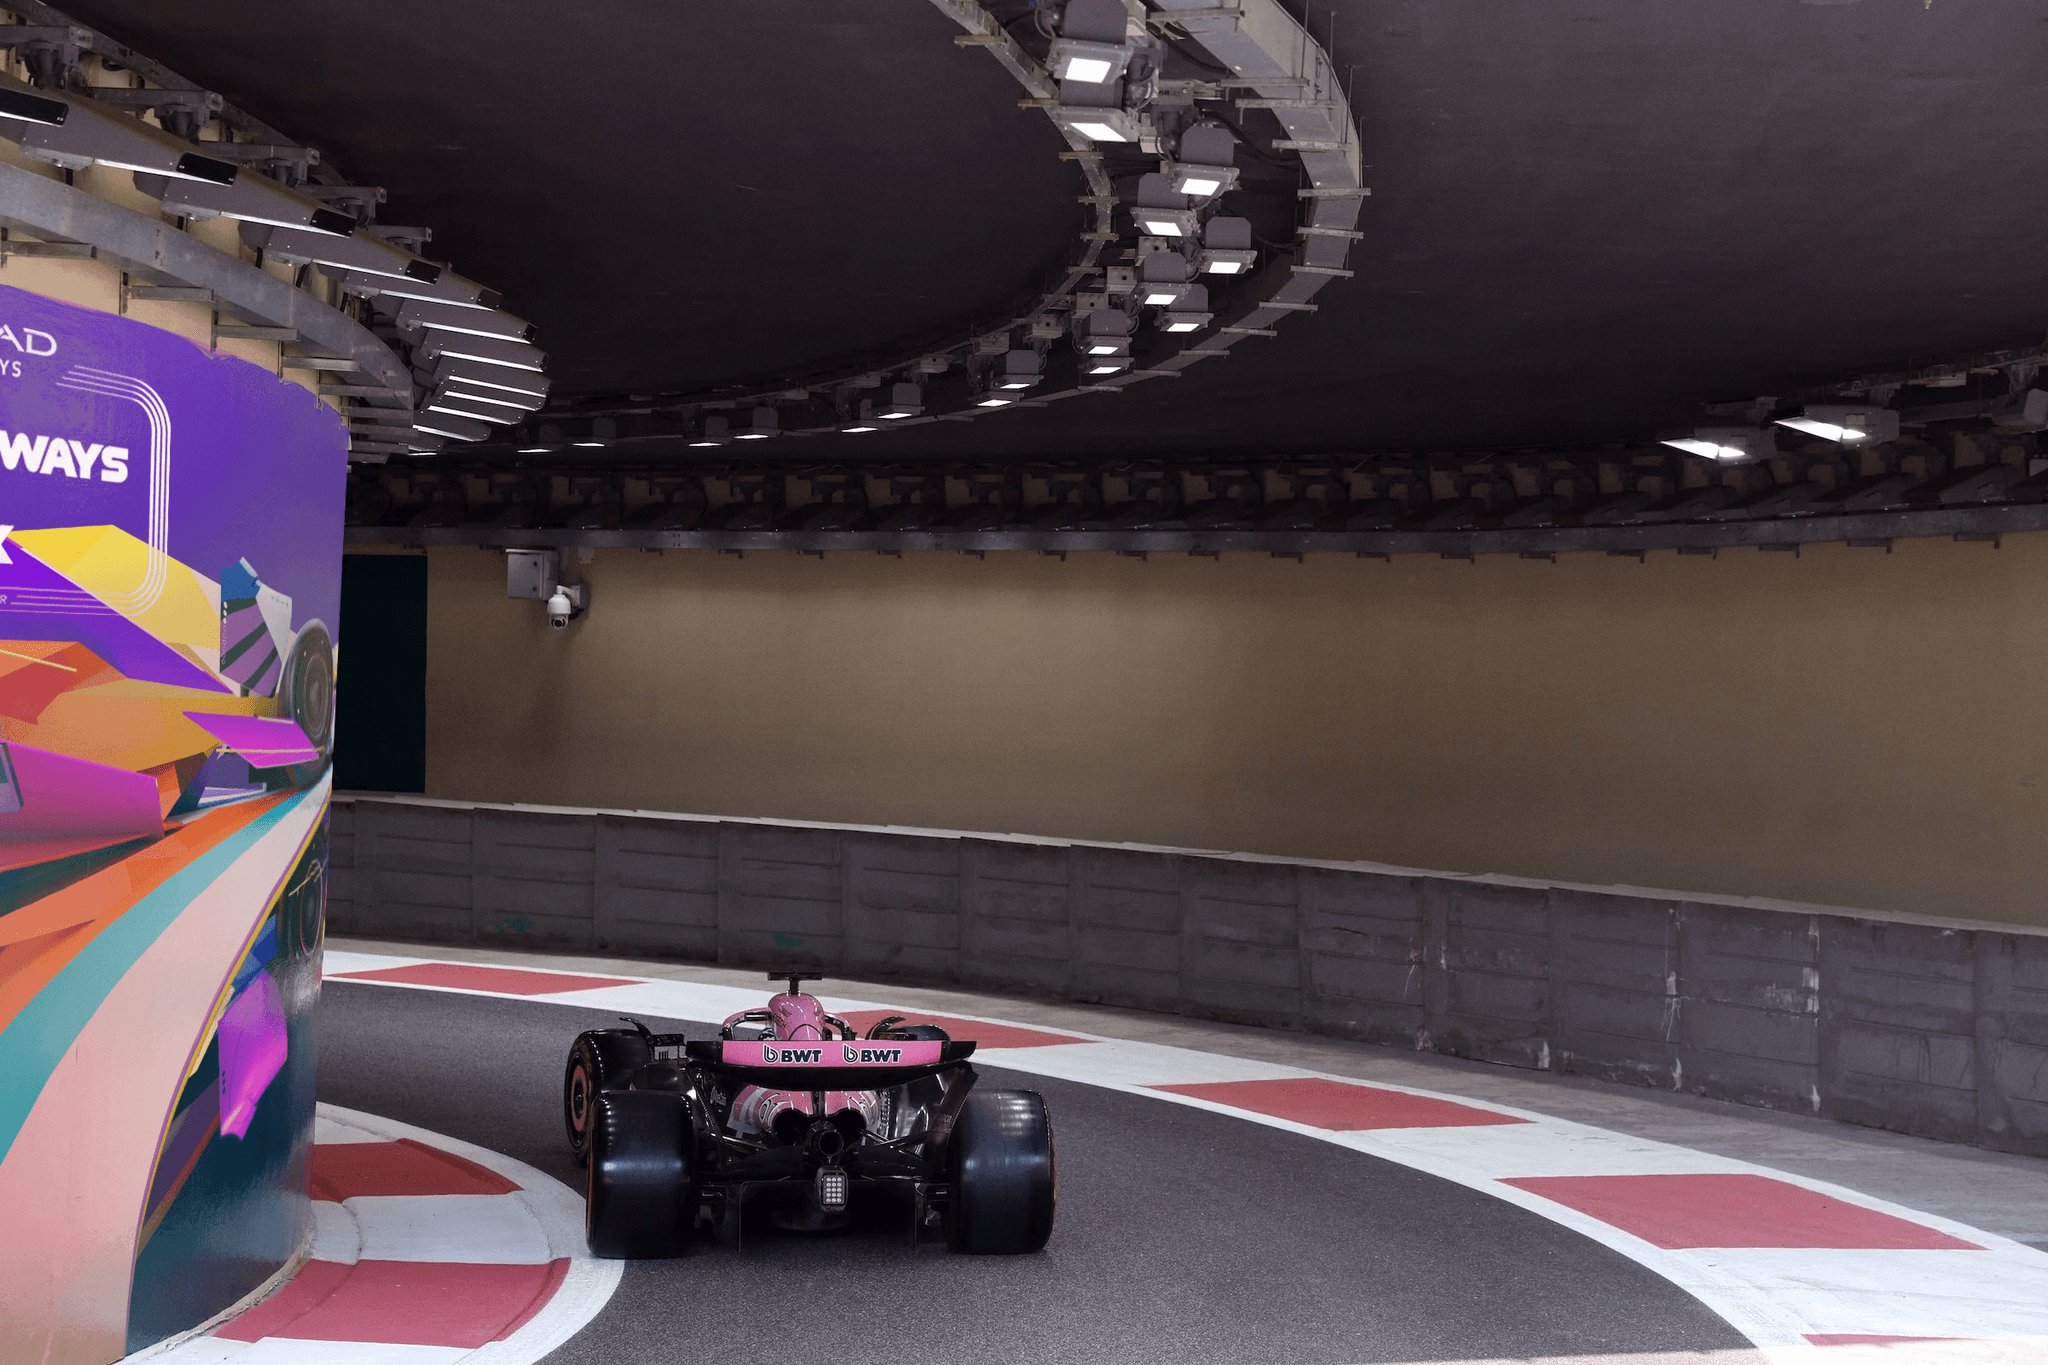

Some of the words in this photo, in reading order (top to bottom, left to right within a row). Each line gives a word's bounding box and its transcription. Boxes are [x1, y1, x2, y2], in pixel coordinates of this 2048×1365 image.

[0, 429, 129, 483] WAYS
[780, 1049, 822, 1063] BWT
[860, 1049, 902, 1063] BWT
